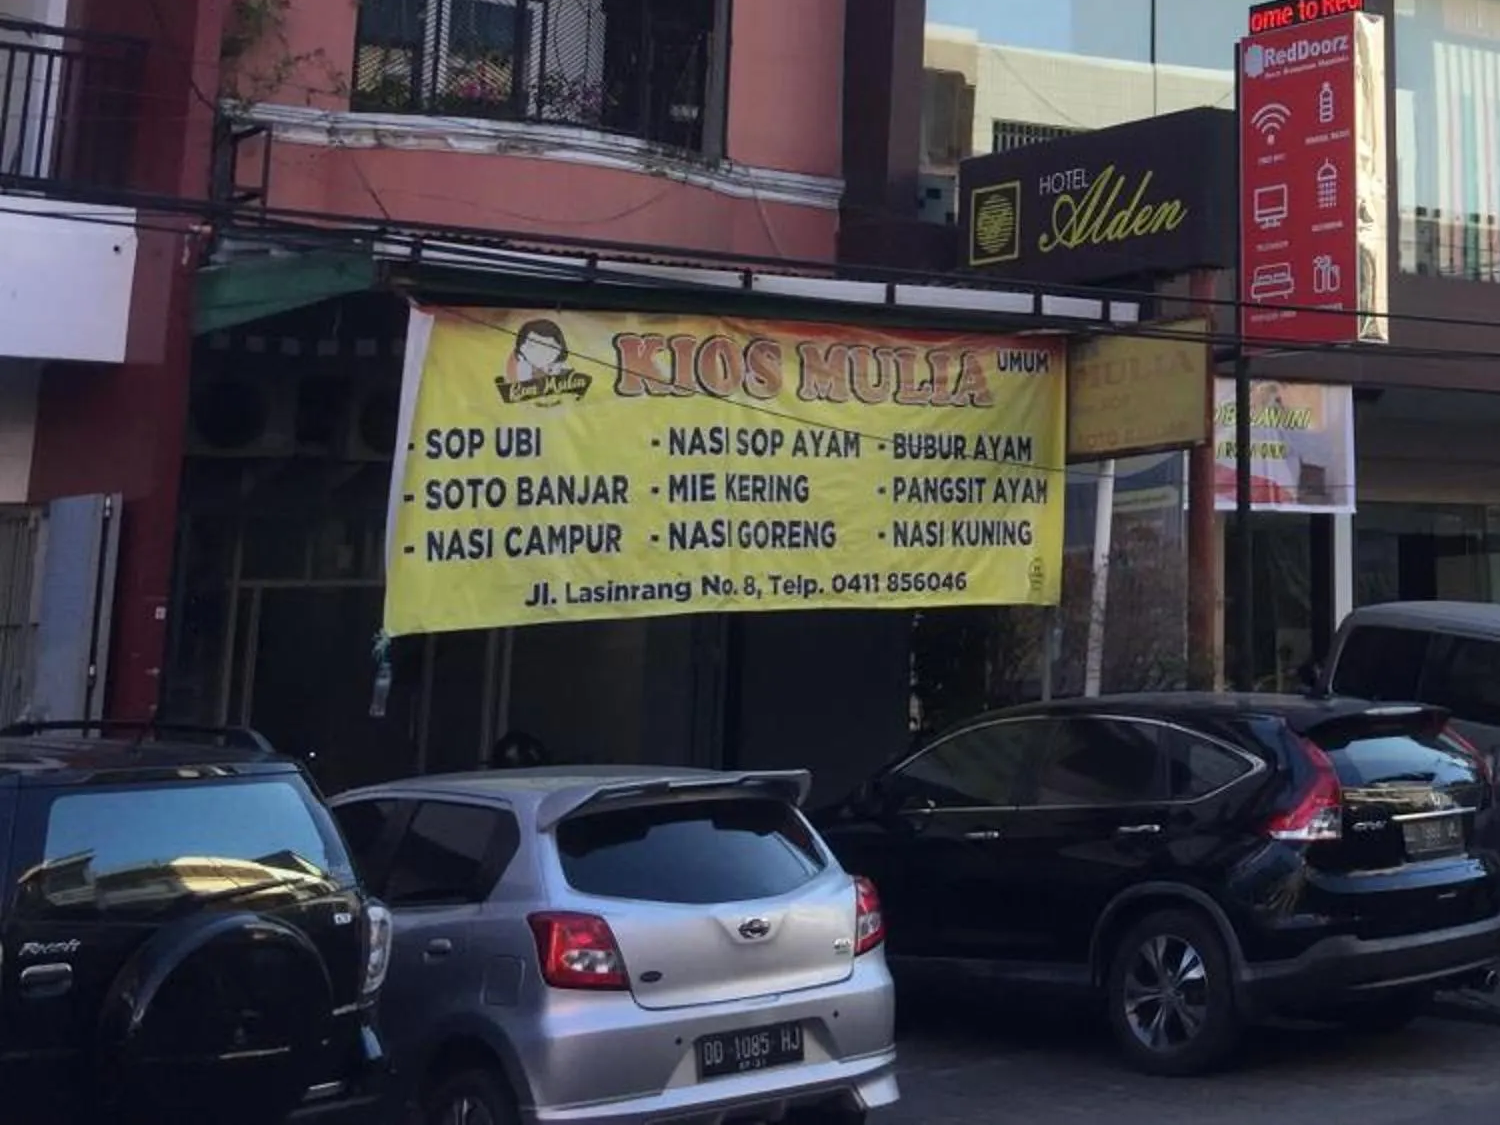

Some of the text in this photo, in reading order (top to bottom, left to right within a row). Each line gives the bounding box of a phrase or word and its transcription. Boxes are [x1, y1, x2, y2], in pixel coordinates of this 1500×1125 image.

[1298, 0, 1317, 21] to
[1265, 35, 1349, 68] RedDoorz
[1039, 167, 1090, 195] HOTEL
[1038, 164, 1188, 253] Alden
[612, 331, 1050, 408] KIOS MULIA UMUM
[426, 428, 540, 459] SOP UBI
[670, 427, 861, 457] NASI SOP AYAM
[892, 433, 1032, 462] BUBUR AYAM
[426, 475, 628, 510] SOTO BANJAR
[669, 473, 809, 503] MIE KERING
[894, 477, 987, 503] PANGSIT
[427, 524, 621, 561] NASI CAMPUR
[669, 520, 836, 550] NASI GORENG
[894, 521, 1032, 547] NASI KUNING
[525, 572, 966, 606] Jl. Lasinrang No. 8, Telp. 0411 856046
[734, 1032, 770, 1061] 1085
[780, 1025, 801, 1053] HJ
